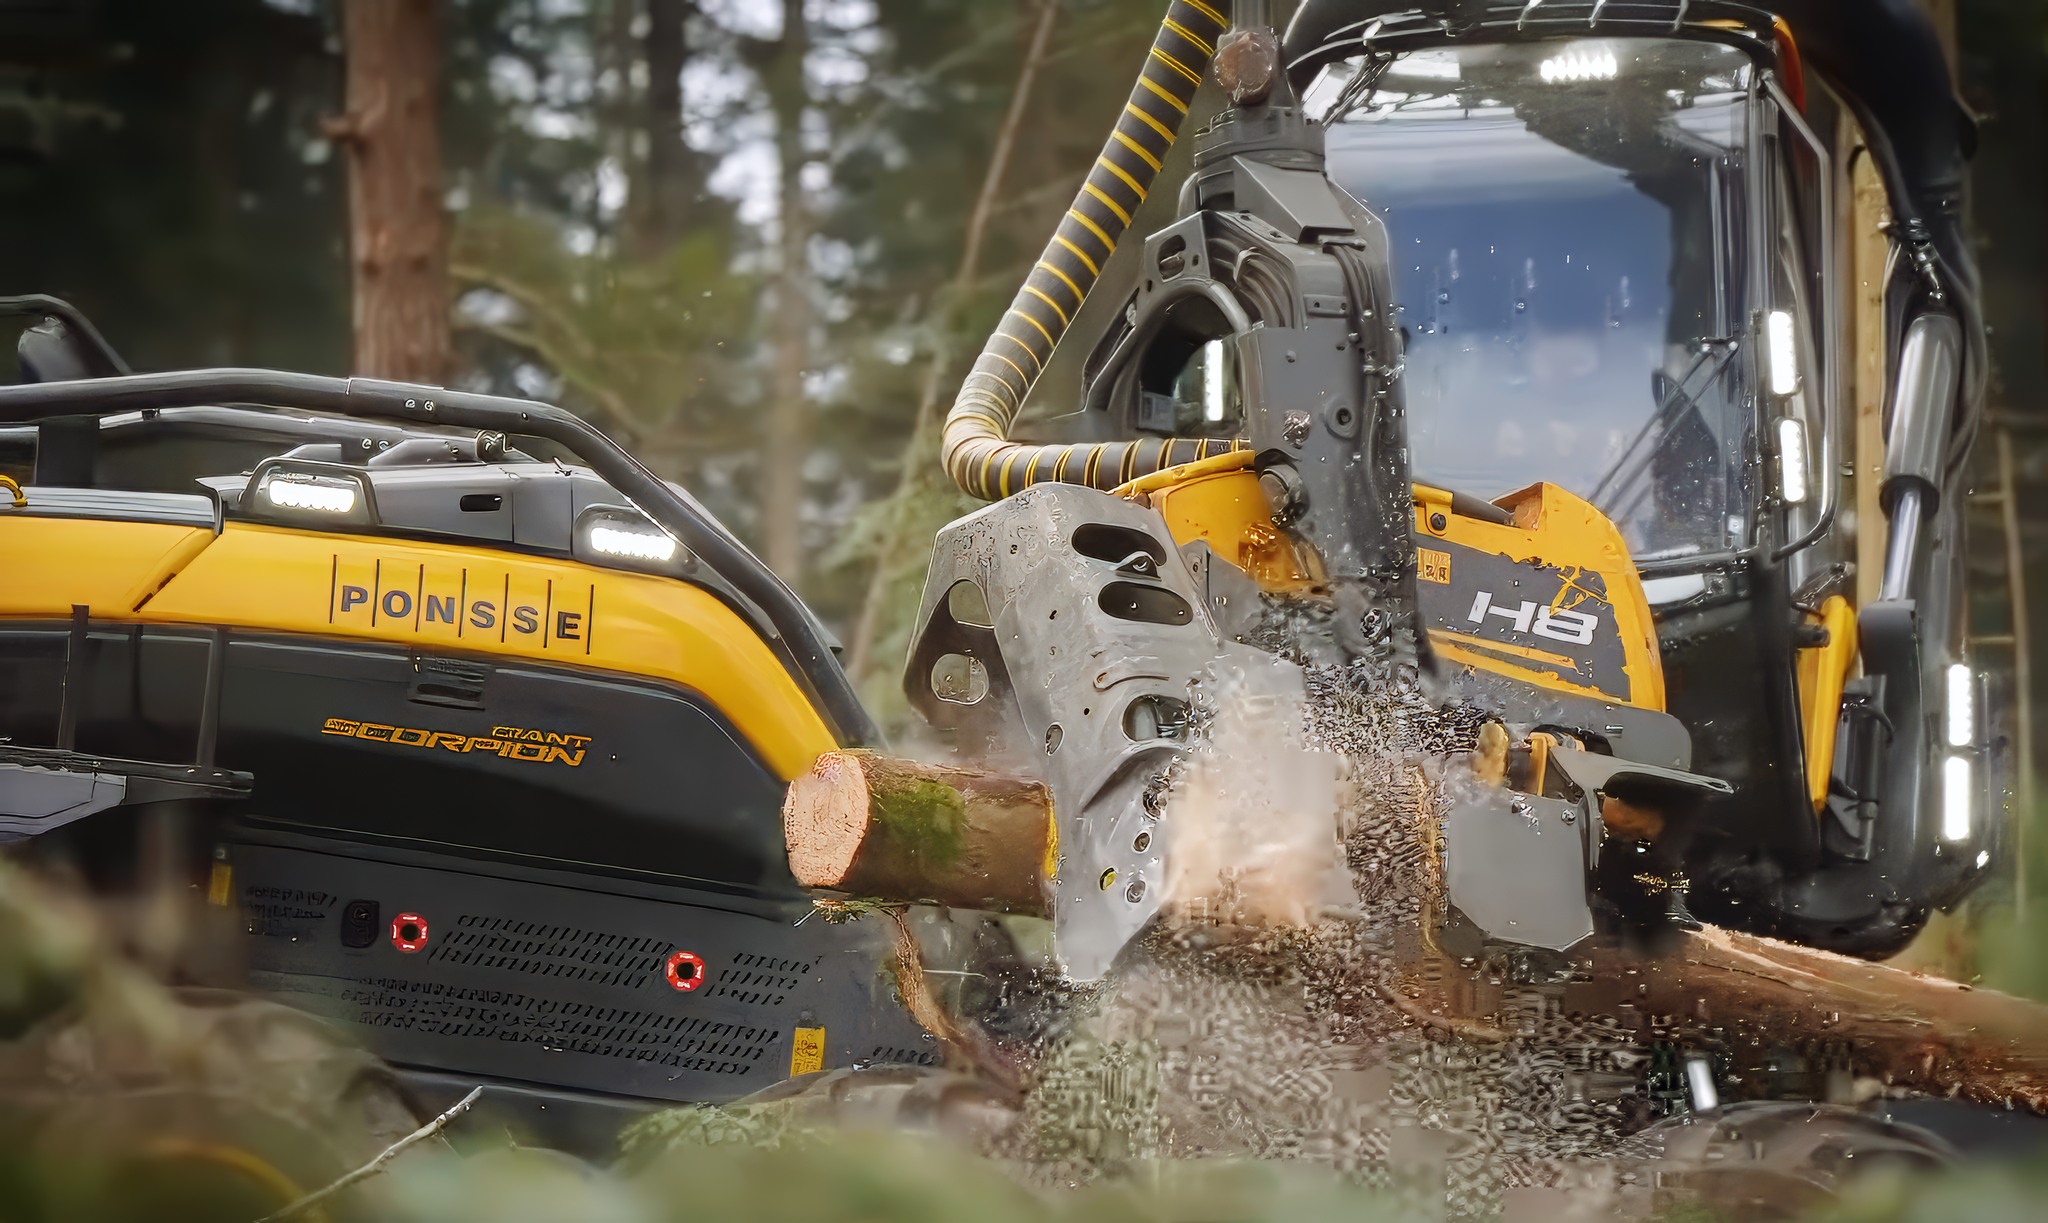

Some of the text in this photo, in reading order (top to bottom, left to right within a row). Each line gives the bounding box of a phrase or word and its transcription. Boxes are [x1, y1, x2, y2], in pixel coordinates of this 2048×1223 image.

[340, 585, 582, 640] PONSSE
[1467, 590, 1599, 646] H8
[321, 717, 587, 767] SCORPION
[492, 725, 592, 750] GIANT
